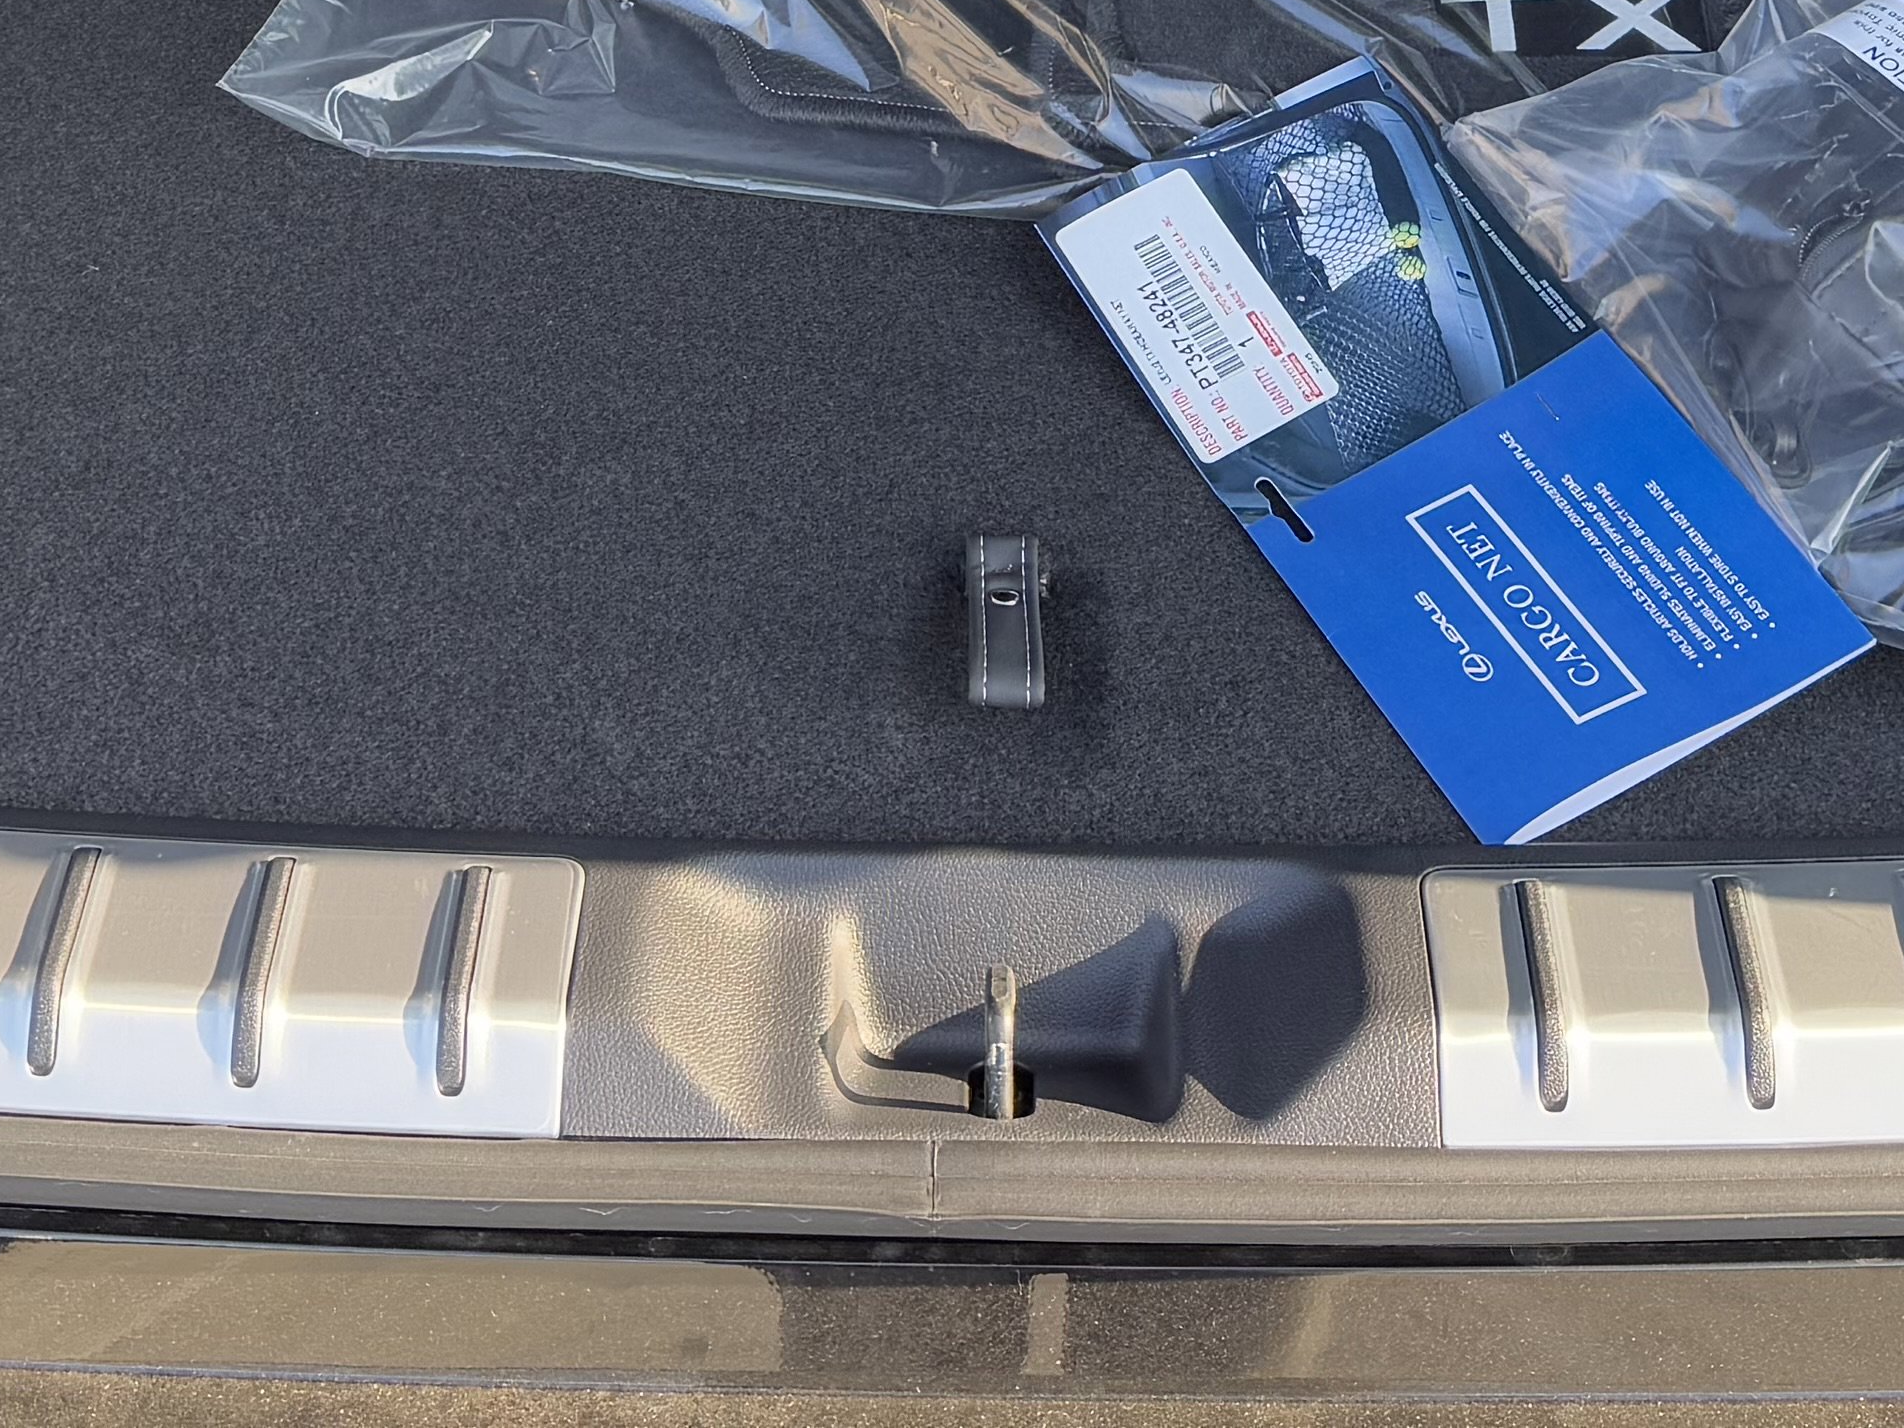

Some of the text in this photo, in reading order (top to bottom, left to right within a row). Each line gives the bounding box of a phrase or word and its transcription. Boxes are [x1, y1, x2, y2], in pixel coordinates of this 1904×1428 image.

[1875, 34, 1893, 47] for
[1135, 279, 1219, 390] PT347-48241
[1236, 335, 1256, 349] 1
[1221, 412, 1248, 441] PART
[1498, 429, 1527, 460] PLACE
[1520, 457, 1535, 470] IN
[1579, 525, 1601, 548] AND
[1639, 535, 1676, 575] AROUND
[1642, 478, 1771, 621] EASY TO STORE WHEN NOT IN USE
[1559, 472, 1716, 652] ELIMINATES SLIDING AND TIPPING OF ITEMS
[1596, 543, 1638, 590] SECURELY
[1669, 571, 1689, 588] FIT
[1445, 515, 1604, 690] CARGO NET
[1673, 544, 1753, 631] EASY INSTALLATION
[1681, 585, 1699, 600] TO
[1412, 589, 1471, 655] LEXUS
[1631, 585, 1672, 631] ARTICLES
[1692, 597, 1735, 642] FLEXIBLE
[1666, 626, 1698, 661] HOLDS
